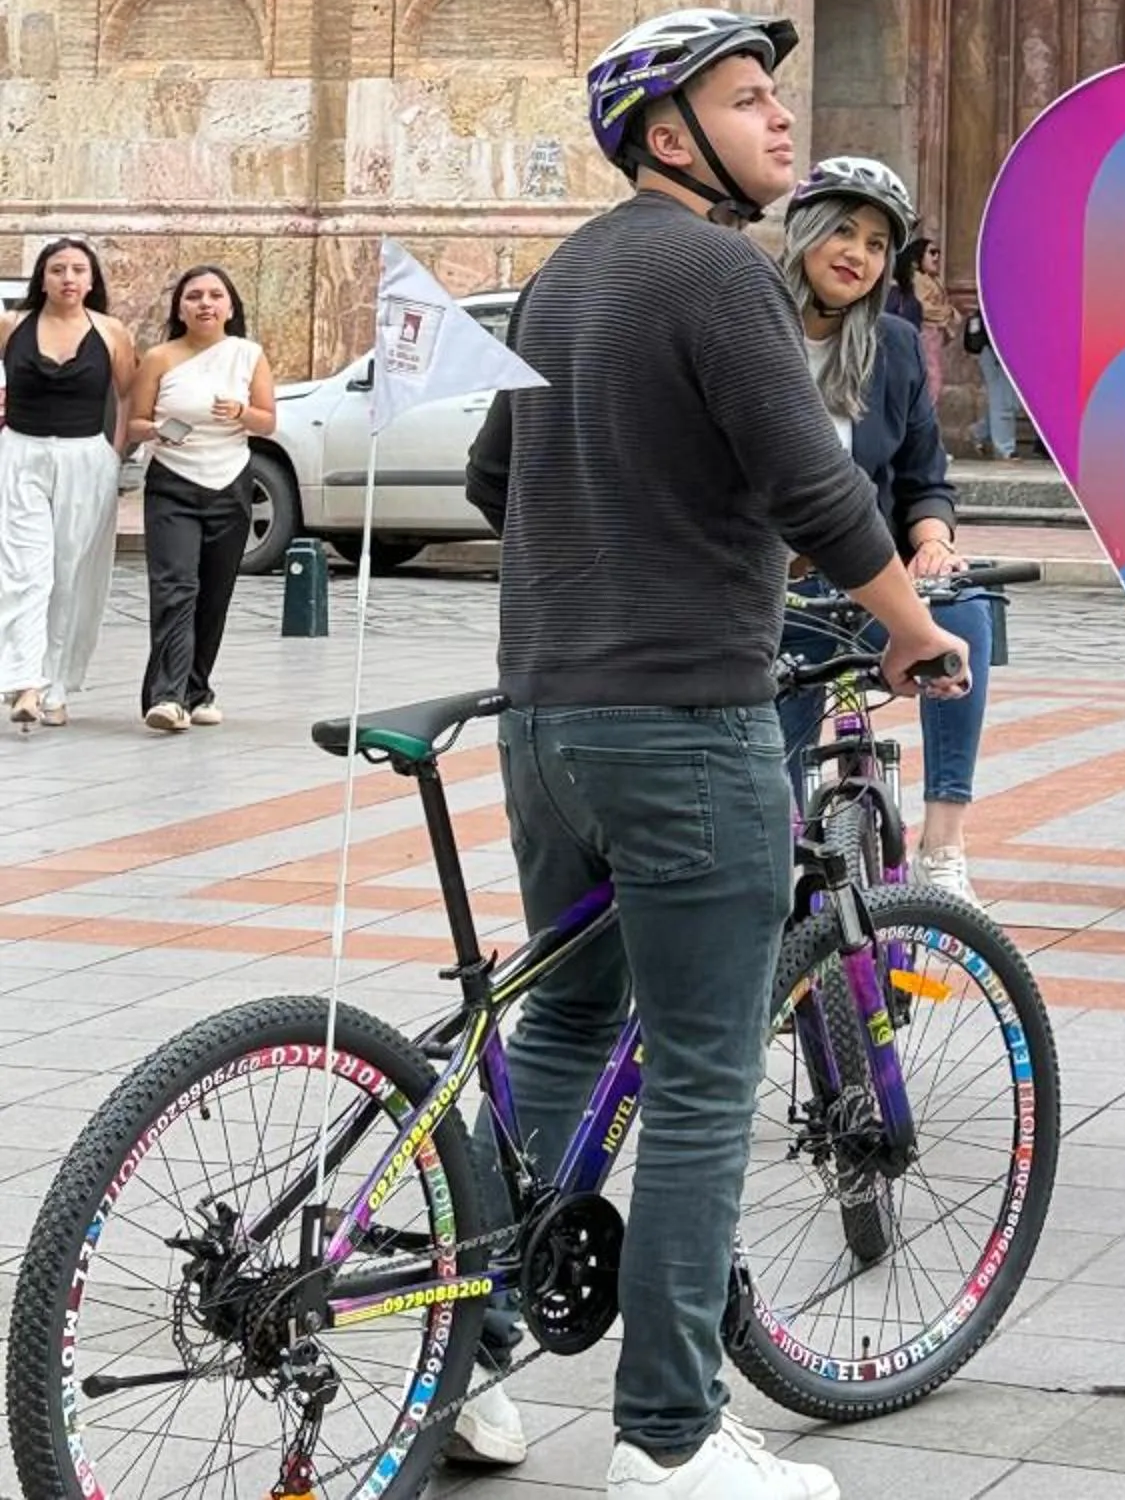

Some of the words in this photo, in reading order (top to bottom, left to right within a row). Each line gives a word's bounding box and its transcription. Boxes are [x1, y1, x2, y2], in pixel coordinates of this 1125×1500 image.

[368, 1075, 460, 1210] 0979088200
[602, 1093, 638, 1155] HOTEL
[383, 1277, 494, 1314] 0979088200
